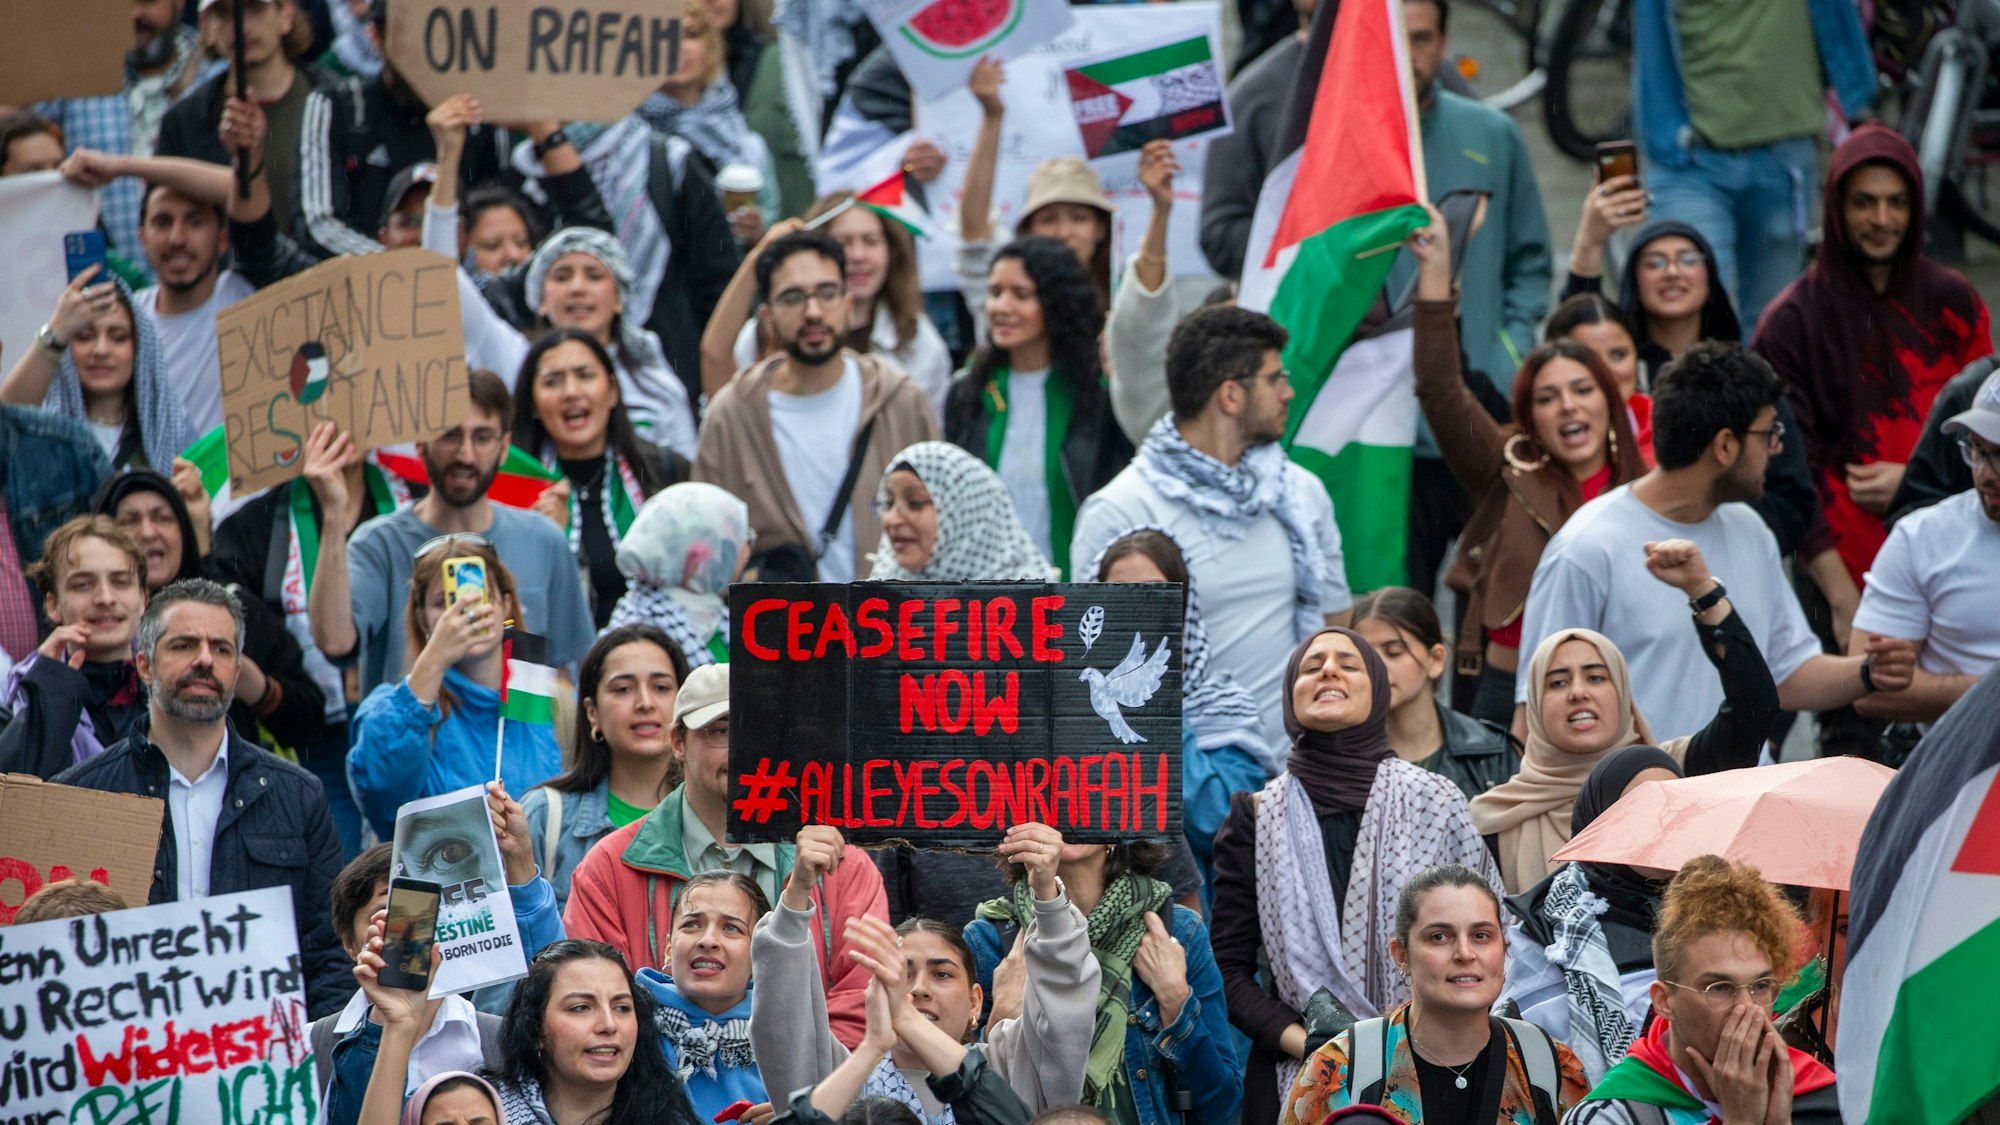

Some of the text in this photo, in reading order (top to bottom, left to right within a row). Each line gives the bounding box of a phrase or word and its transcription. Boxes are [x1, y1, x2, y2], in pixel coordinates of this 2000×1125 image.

[424, 7, 682, 77] ON RAFAH
[742, 595, 1066, 662] CEASEFIRE
[899, 668, 1019, 737] NOW
[732, 751, 1169, 832] #ALLEYESONRAFAH
[0, 904, 263, 985] enn Unrecht
[433, 911, 495, 943] ESTINE
[444, 942, 478, 961] BORN
[478, 937, 492, 953] TO
[492, 934, 514, 950] DIE
[0, 954, 301, 1041] u Recht wird
